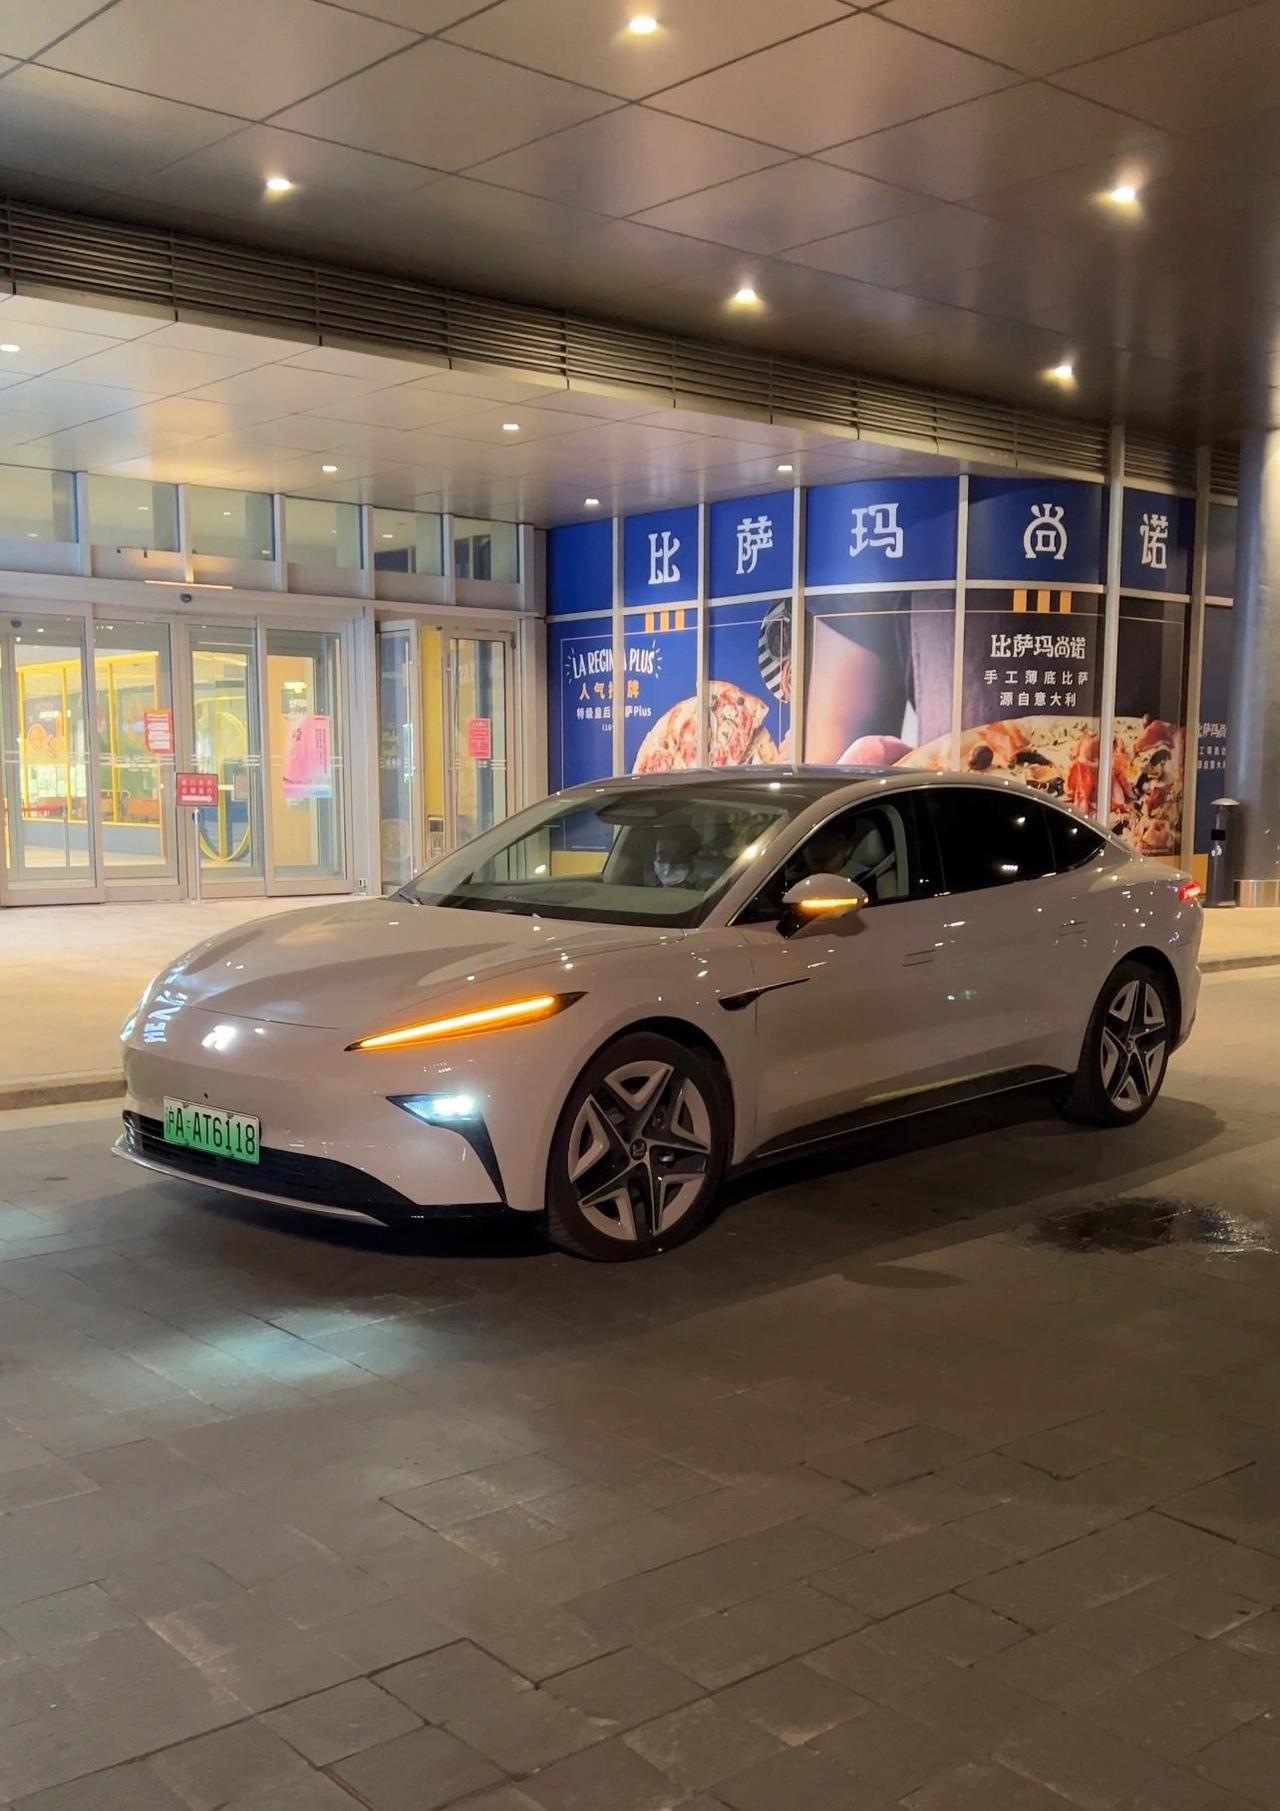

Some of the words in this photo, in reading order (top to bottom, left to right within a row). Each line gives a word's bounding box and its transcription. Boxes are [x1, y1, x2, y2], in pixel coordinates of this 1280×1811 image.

[648, 502, 1169, 585] 比萨玛尚诺
[990, 634, 1086, 659] 比萨玛尚诺
[572, 654, 587, 679] LA
[629, 648, 655, 674] PLUS
[984, 669, 1089, 685] 手工薄底比萨
[1000, 691, 1076, 707] 源自意大利
